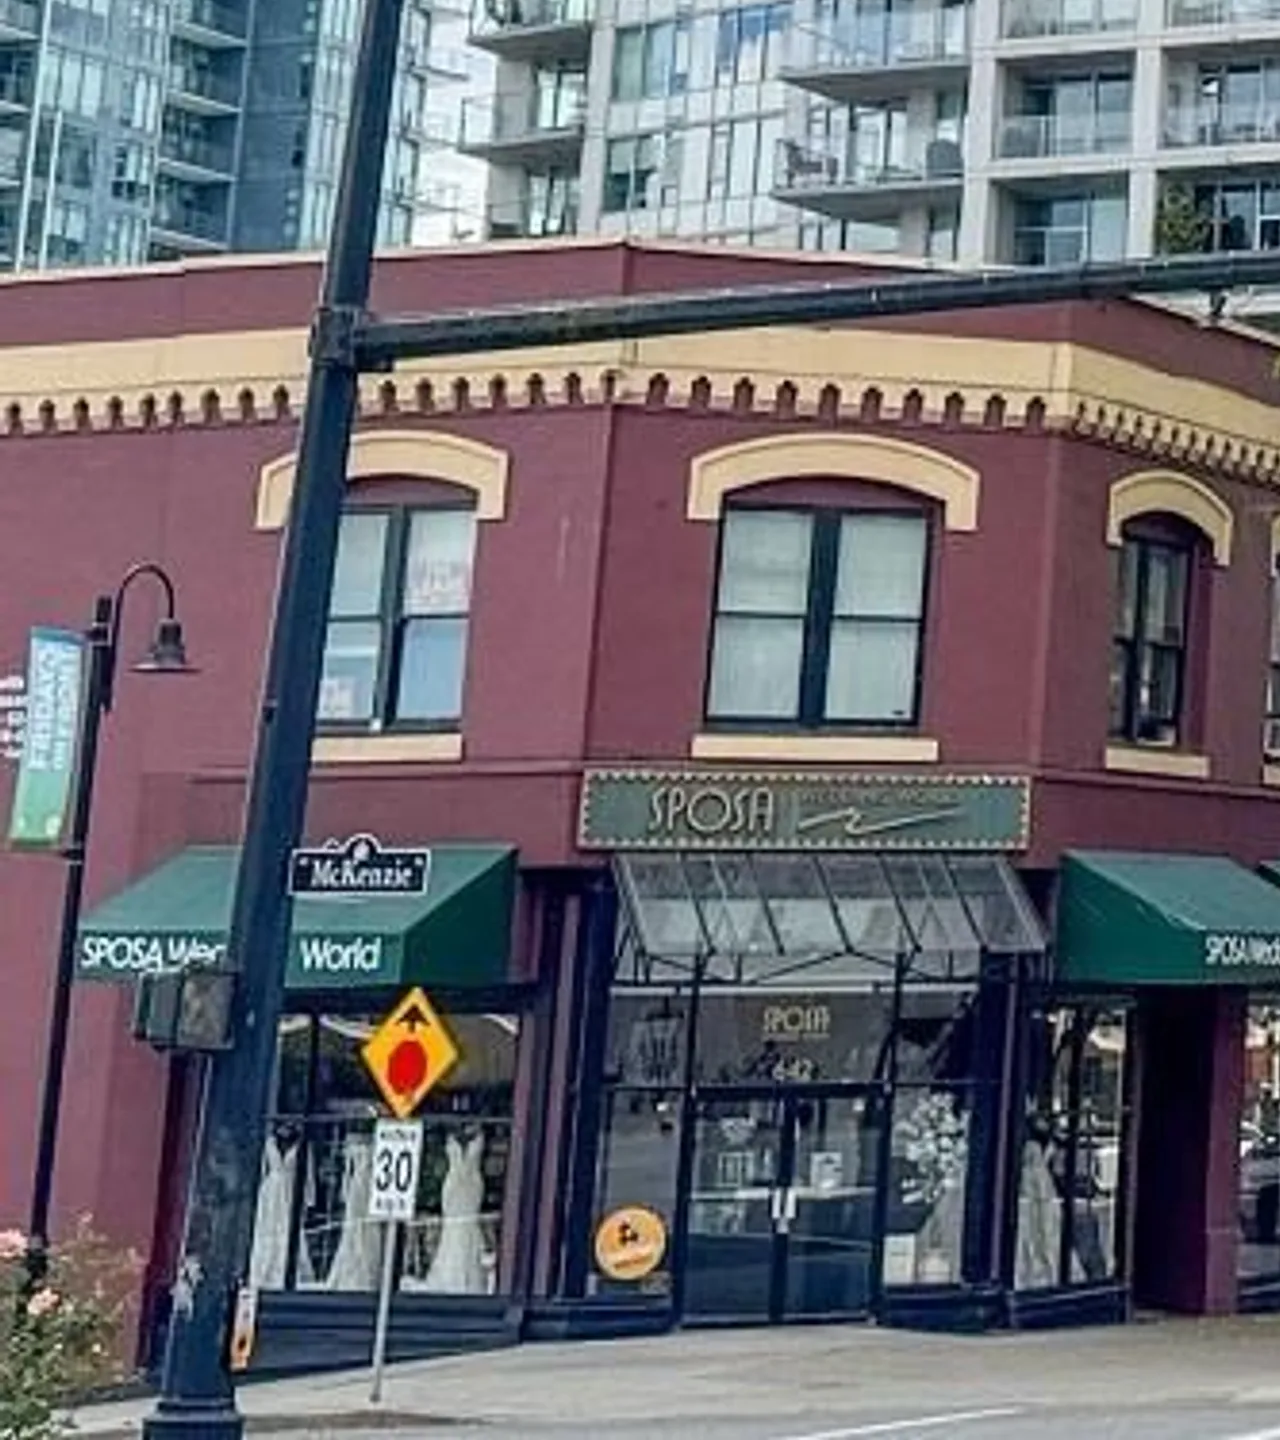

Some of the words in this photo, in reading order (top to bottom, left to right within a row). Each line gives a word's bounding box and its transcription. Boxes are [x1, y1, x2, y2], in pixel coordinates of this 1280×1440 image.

[648, 785, 775, 832] SPOSA
[310, 860, 414, 888] McKenzie
[80, 935, 164, 970] SPOSA
[299, 936, 382, 971] World
[376, 1147, 413, 1192] 30
